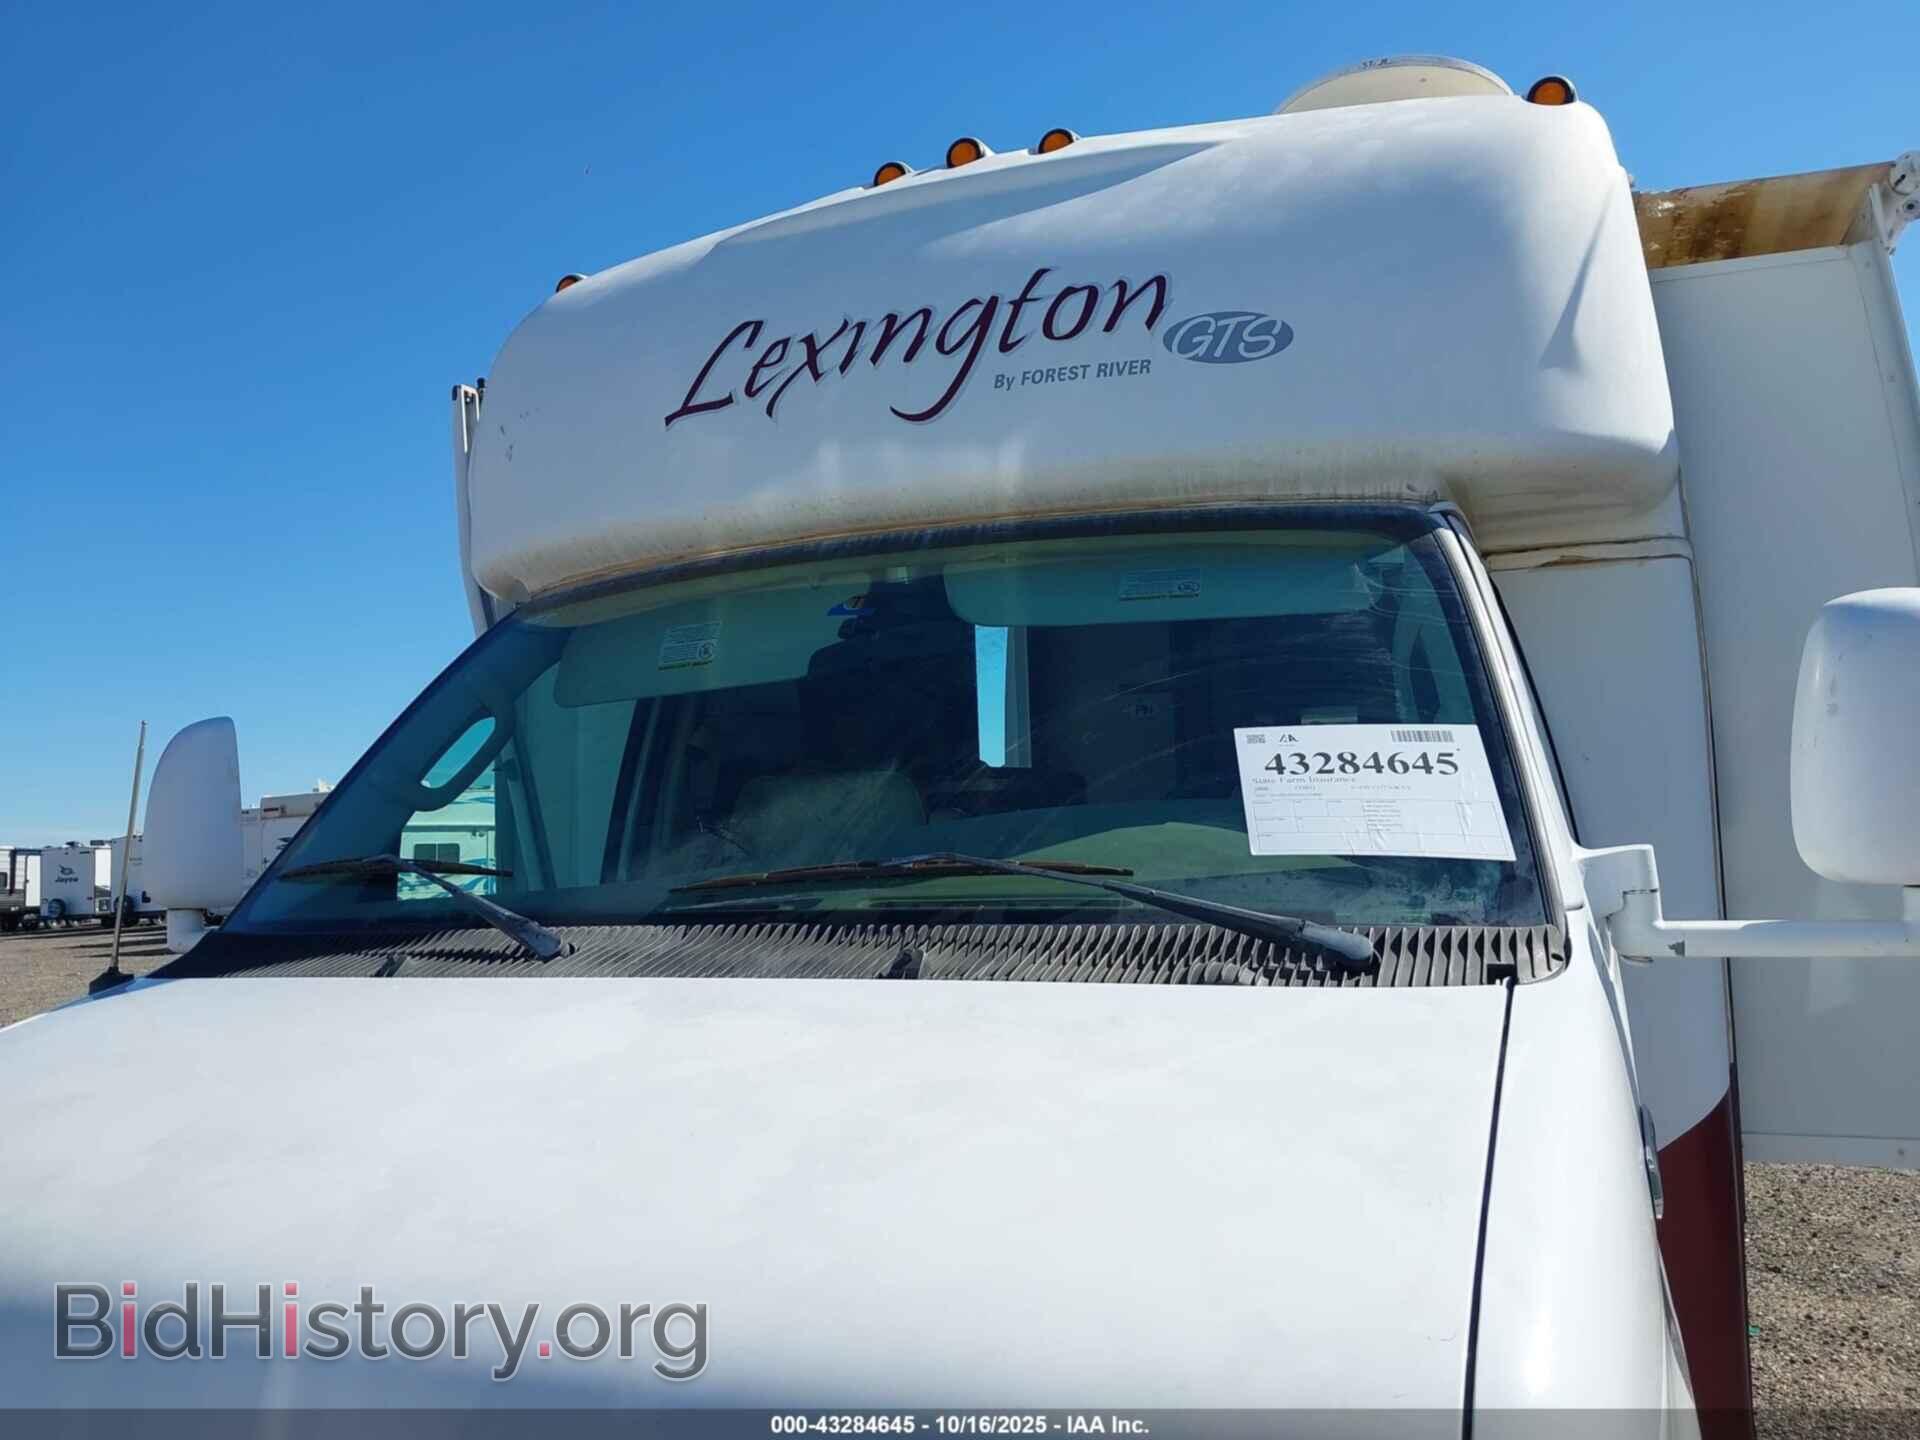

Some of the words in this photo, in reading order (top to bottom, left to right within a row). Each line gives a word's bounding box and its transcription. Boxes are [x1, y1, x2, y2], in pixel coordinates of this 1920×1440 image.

[664, 267, 1169, 425] Lexington
[1171, 317, 1287, 360] GTS
[993, 373, 1016, 391] By
[1020, 363, 1091, 386] FOREST
[1096, 359, 1152, 378] RIVER
[1264, 751, 1459, 776] 43284645
